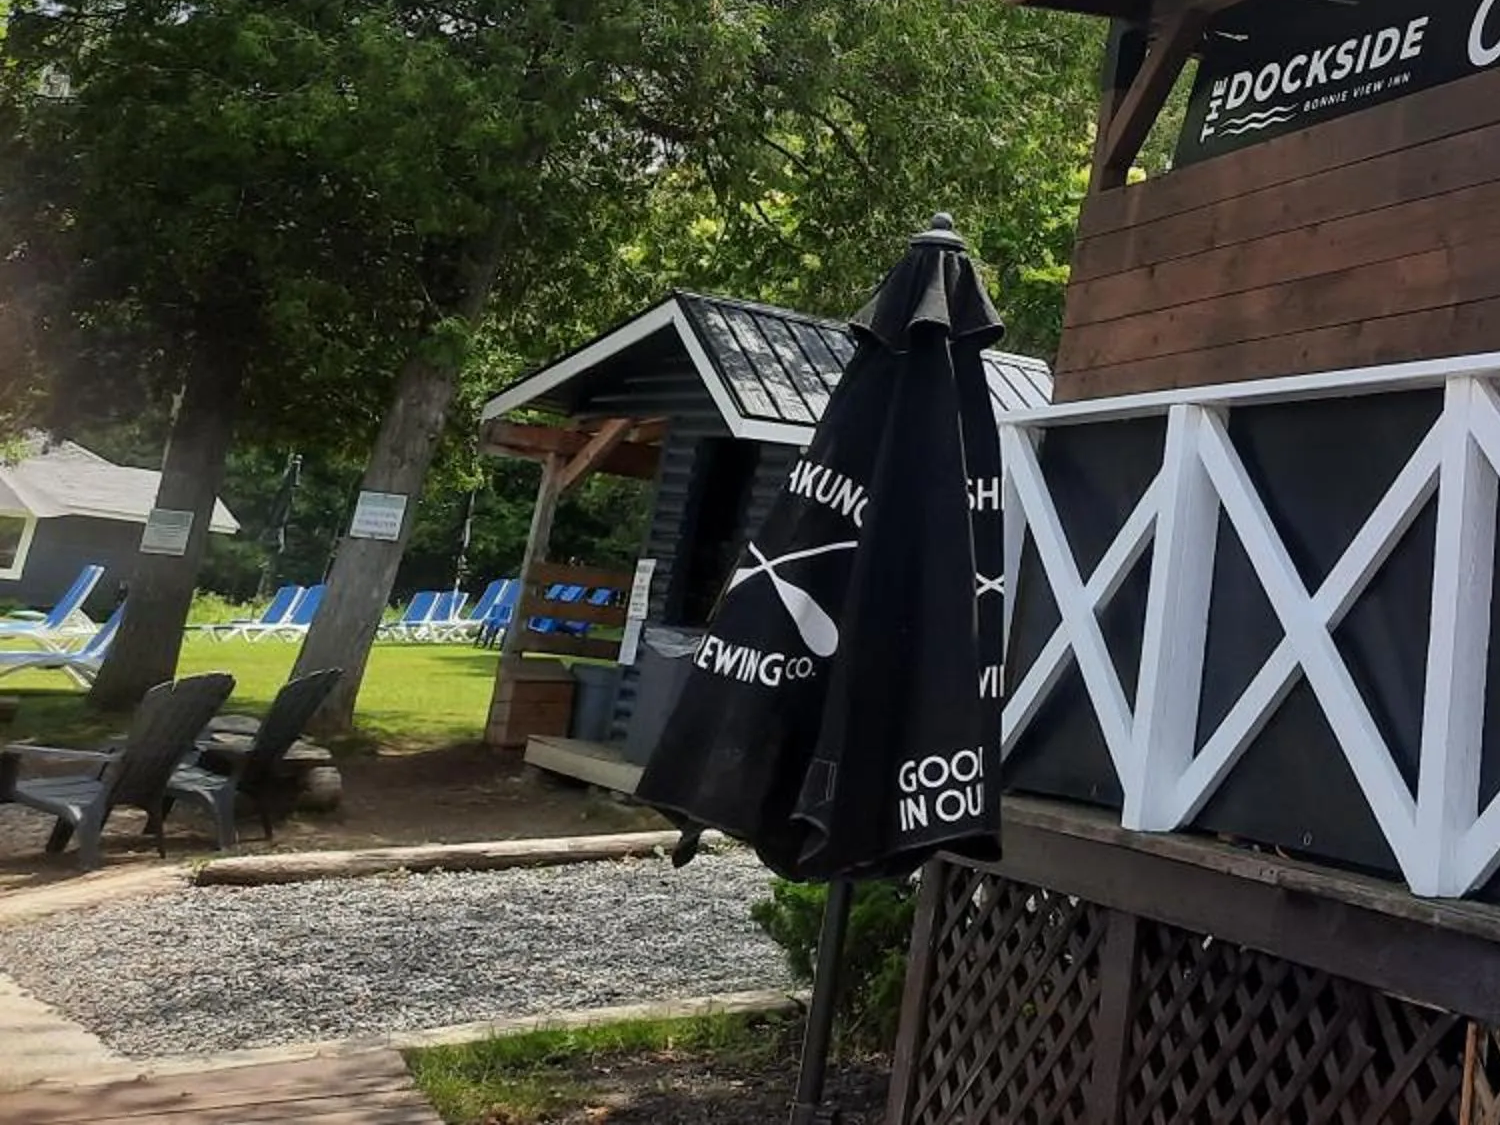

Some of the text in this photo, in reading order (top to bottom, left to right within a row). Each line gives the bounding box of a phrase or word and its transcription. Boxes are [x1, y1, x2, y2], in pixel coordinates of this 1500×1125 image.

[1200, 16, 1430, 143] THE DOCKSIDE
[1303, 72, 1412, 113] BONNIE VIEW INN
[694, 633, 785, 687] EWING
[900, 794, 929, 832] IN
